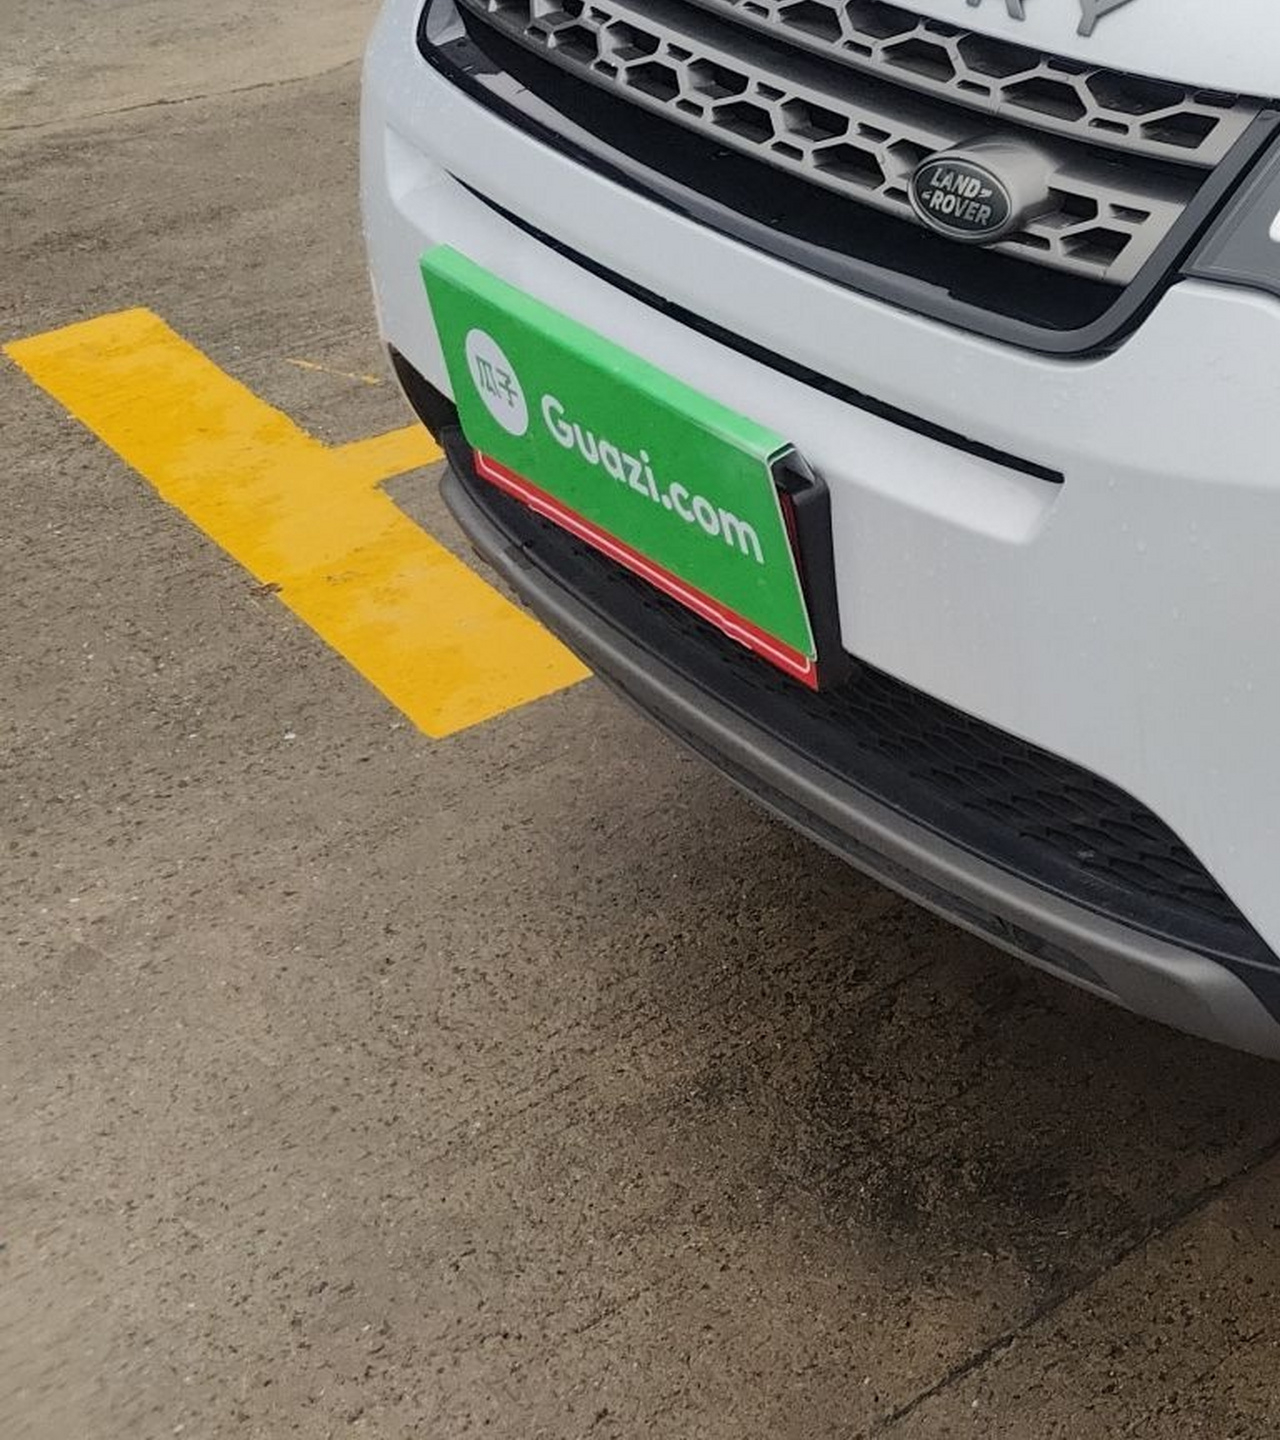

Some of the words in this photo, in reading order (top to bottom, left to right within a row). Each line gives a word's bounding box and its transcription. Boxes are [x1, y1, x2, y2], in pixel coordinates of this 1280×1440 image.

[929, 167, 982, 199] LAND
[929, 189, 992, 226] ROVER
[475, 355, 518, 409] 瓜子
[540, 393, 765, 565] Guazi.com
